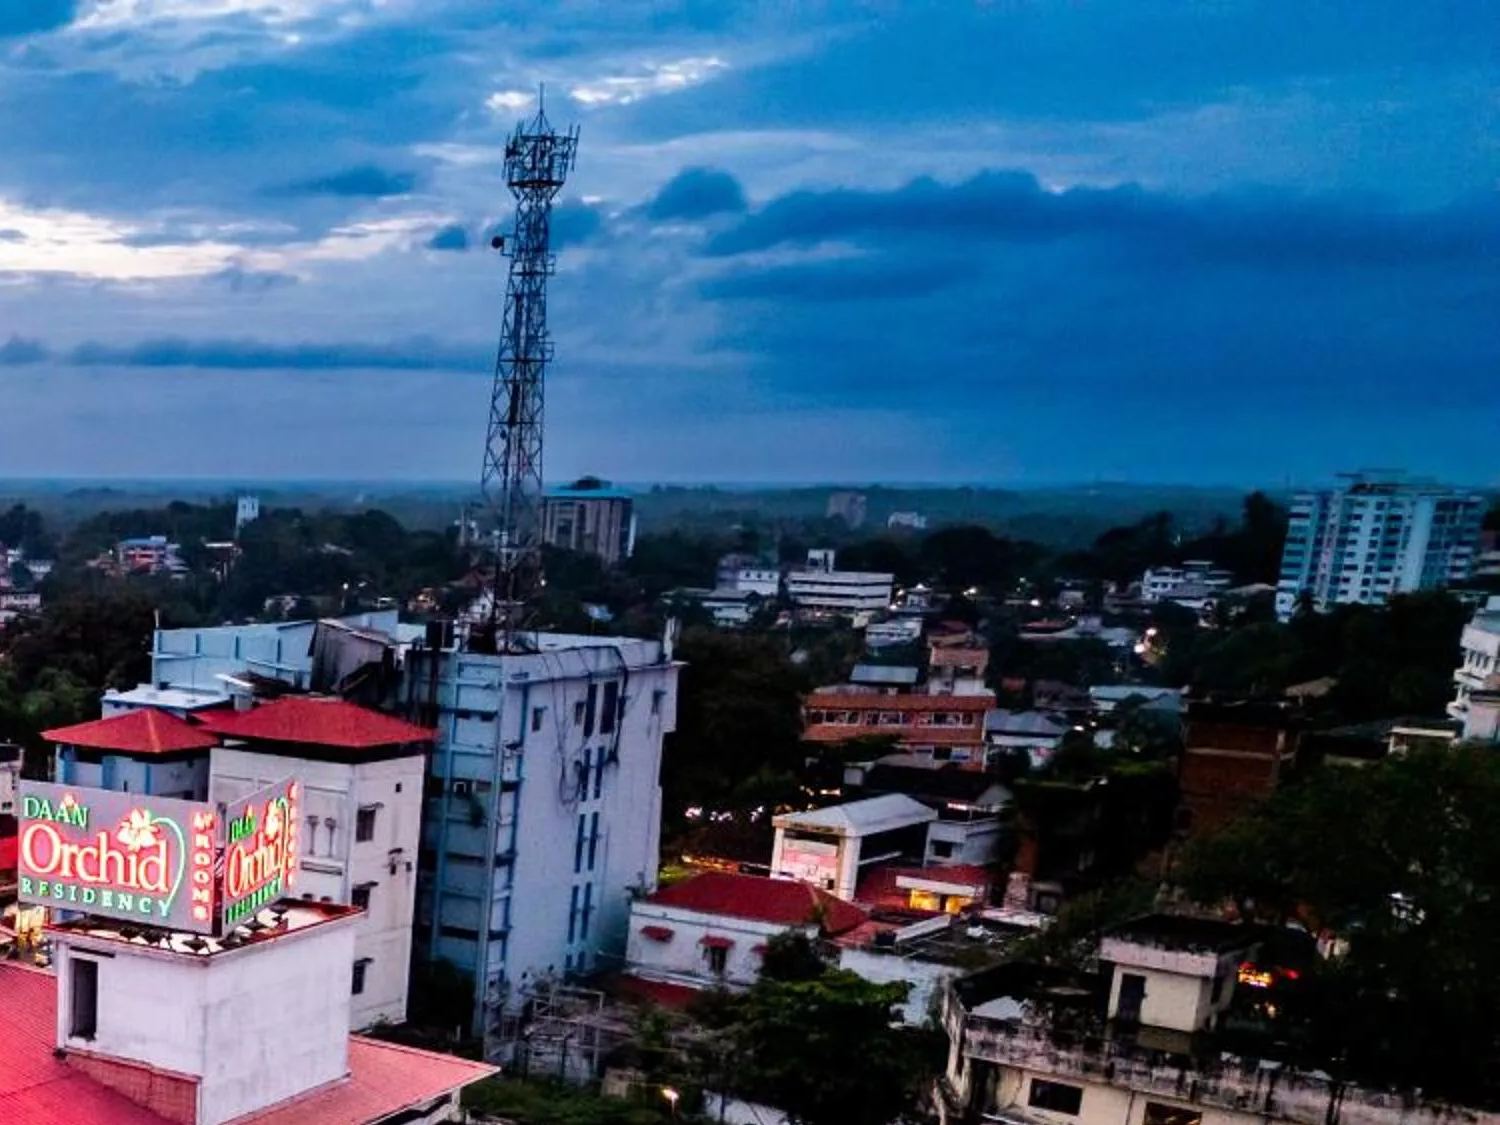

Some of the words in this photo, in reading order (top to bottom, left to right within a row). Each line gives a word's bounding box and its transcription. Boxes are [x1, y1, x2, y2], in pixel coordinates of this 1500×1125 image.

[23, 797, 88, 830] DAAN
[21, 823, 169, 893] Orchid
[21, 877, 171, 917] RESIDENCY
